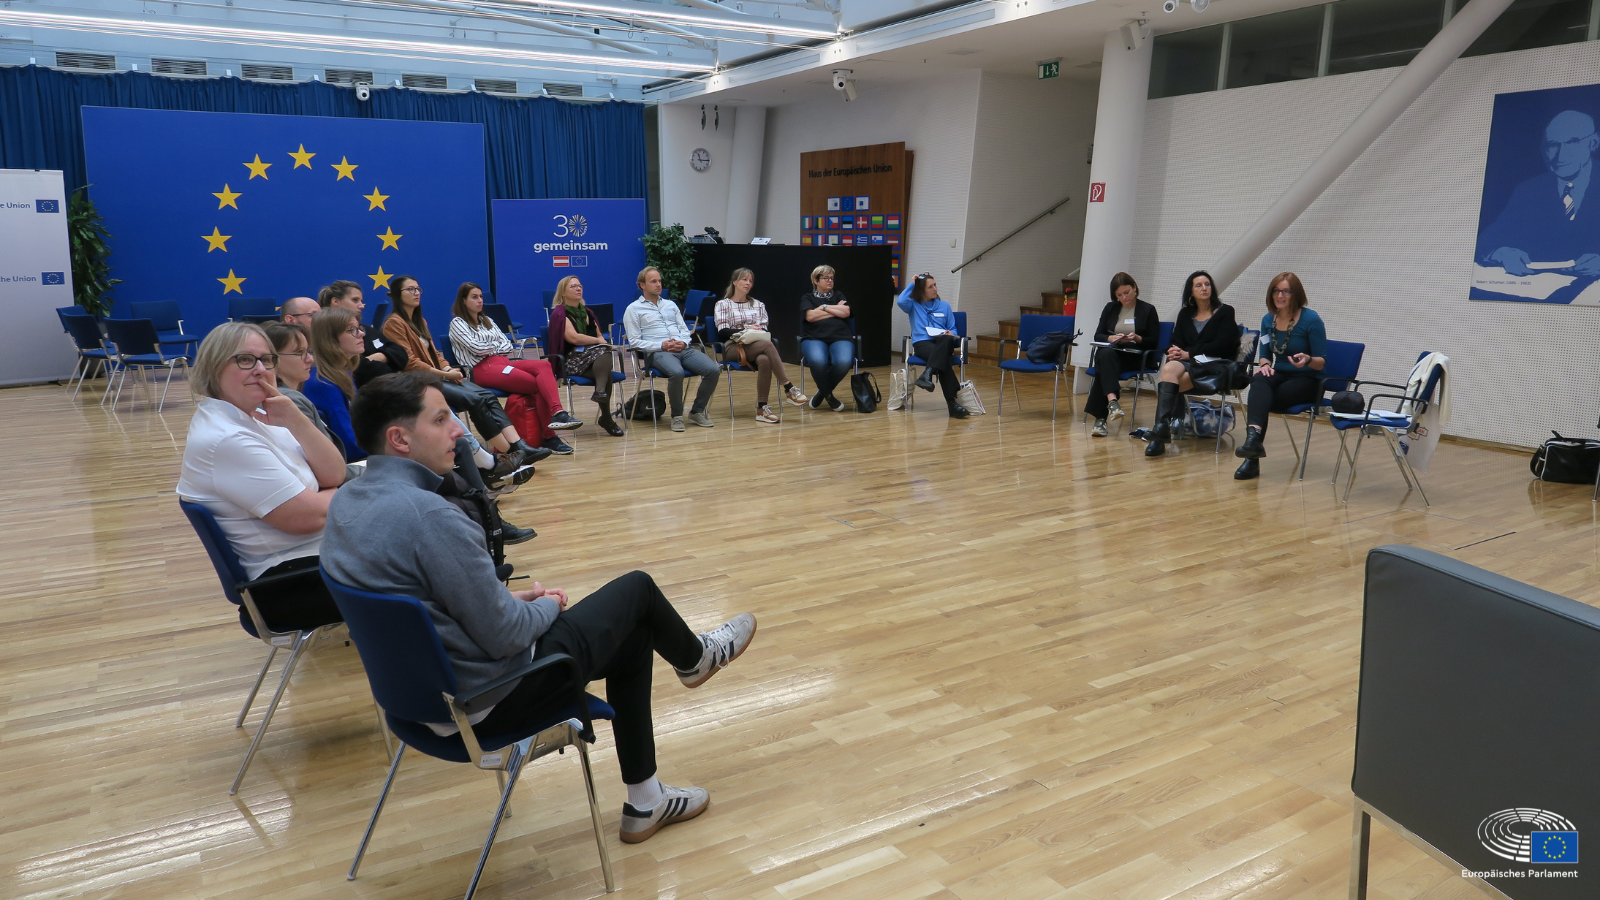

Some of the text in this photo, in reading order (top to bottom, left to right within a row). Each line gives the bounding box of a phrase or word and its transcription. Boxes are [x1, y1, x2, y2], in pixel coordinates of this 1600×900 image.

[808, 163, 893, 178] Haus der Europäischen Union
[533, 240, 608, 254] gemeinsam
[12, 275, 37, 283] Union
